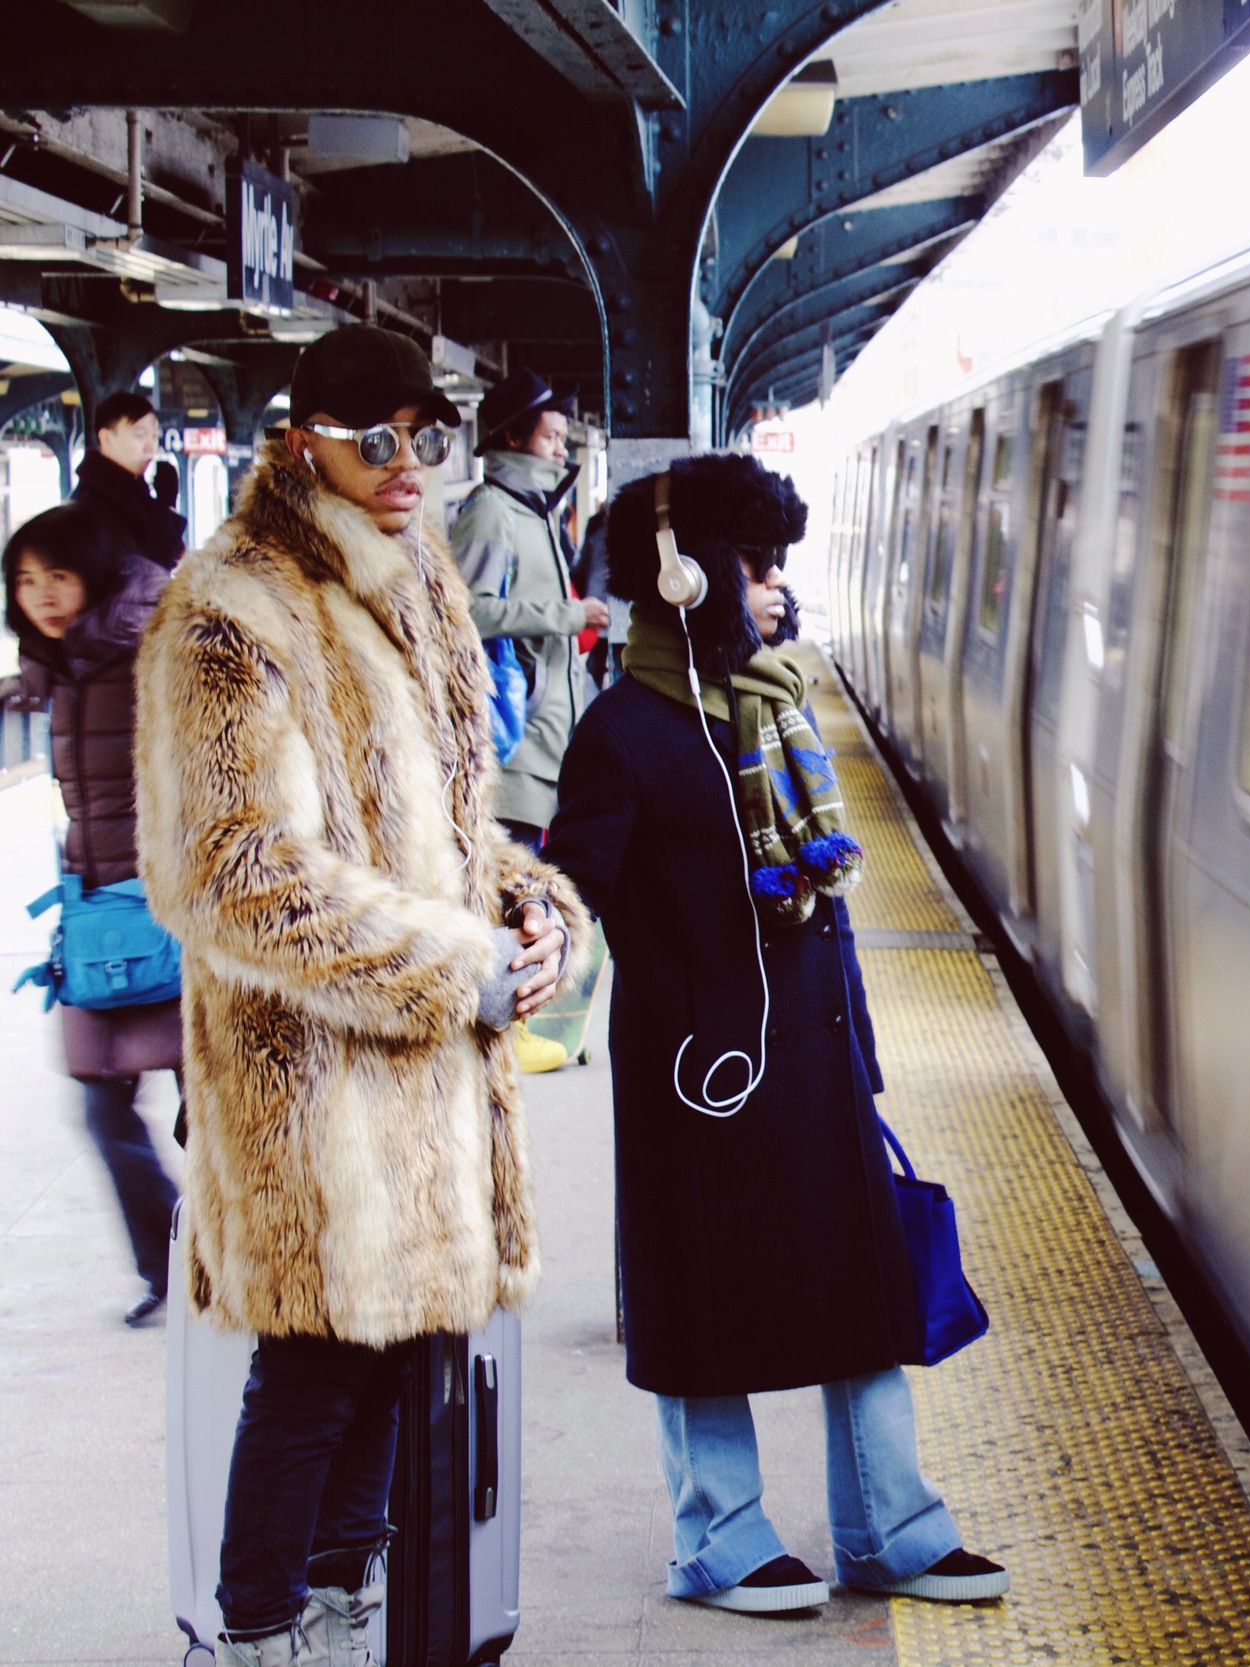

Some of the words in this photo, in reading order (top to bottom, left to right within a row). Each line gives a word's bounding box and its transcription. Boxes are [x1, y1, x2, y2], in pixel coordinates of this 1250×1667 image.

[242, 180, 278, 289] Myrtle
[280, 201, 294, 282] Av
[184, 428, 226, 450] Exit
